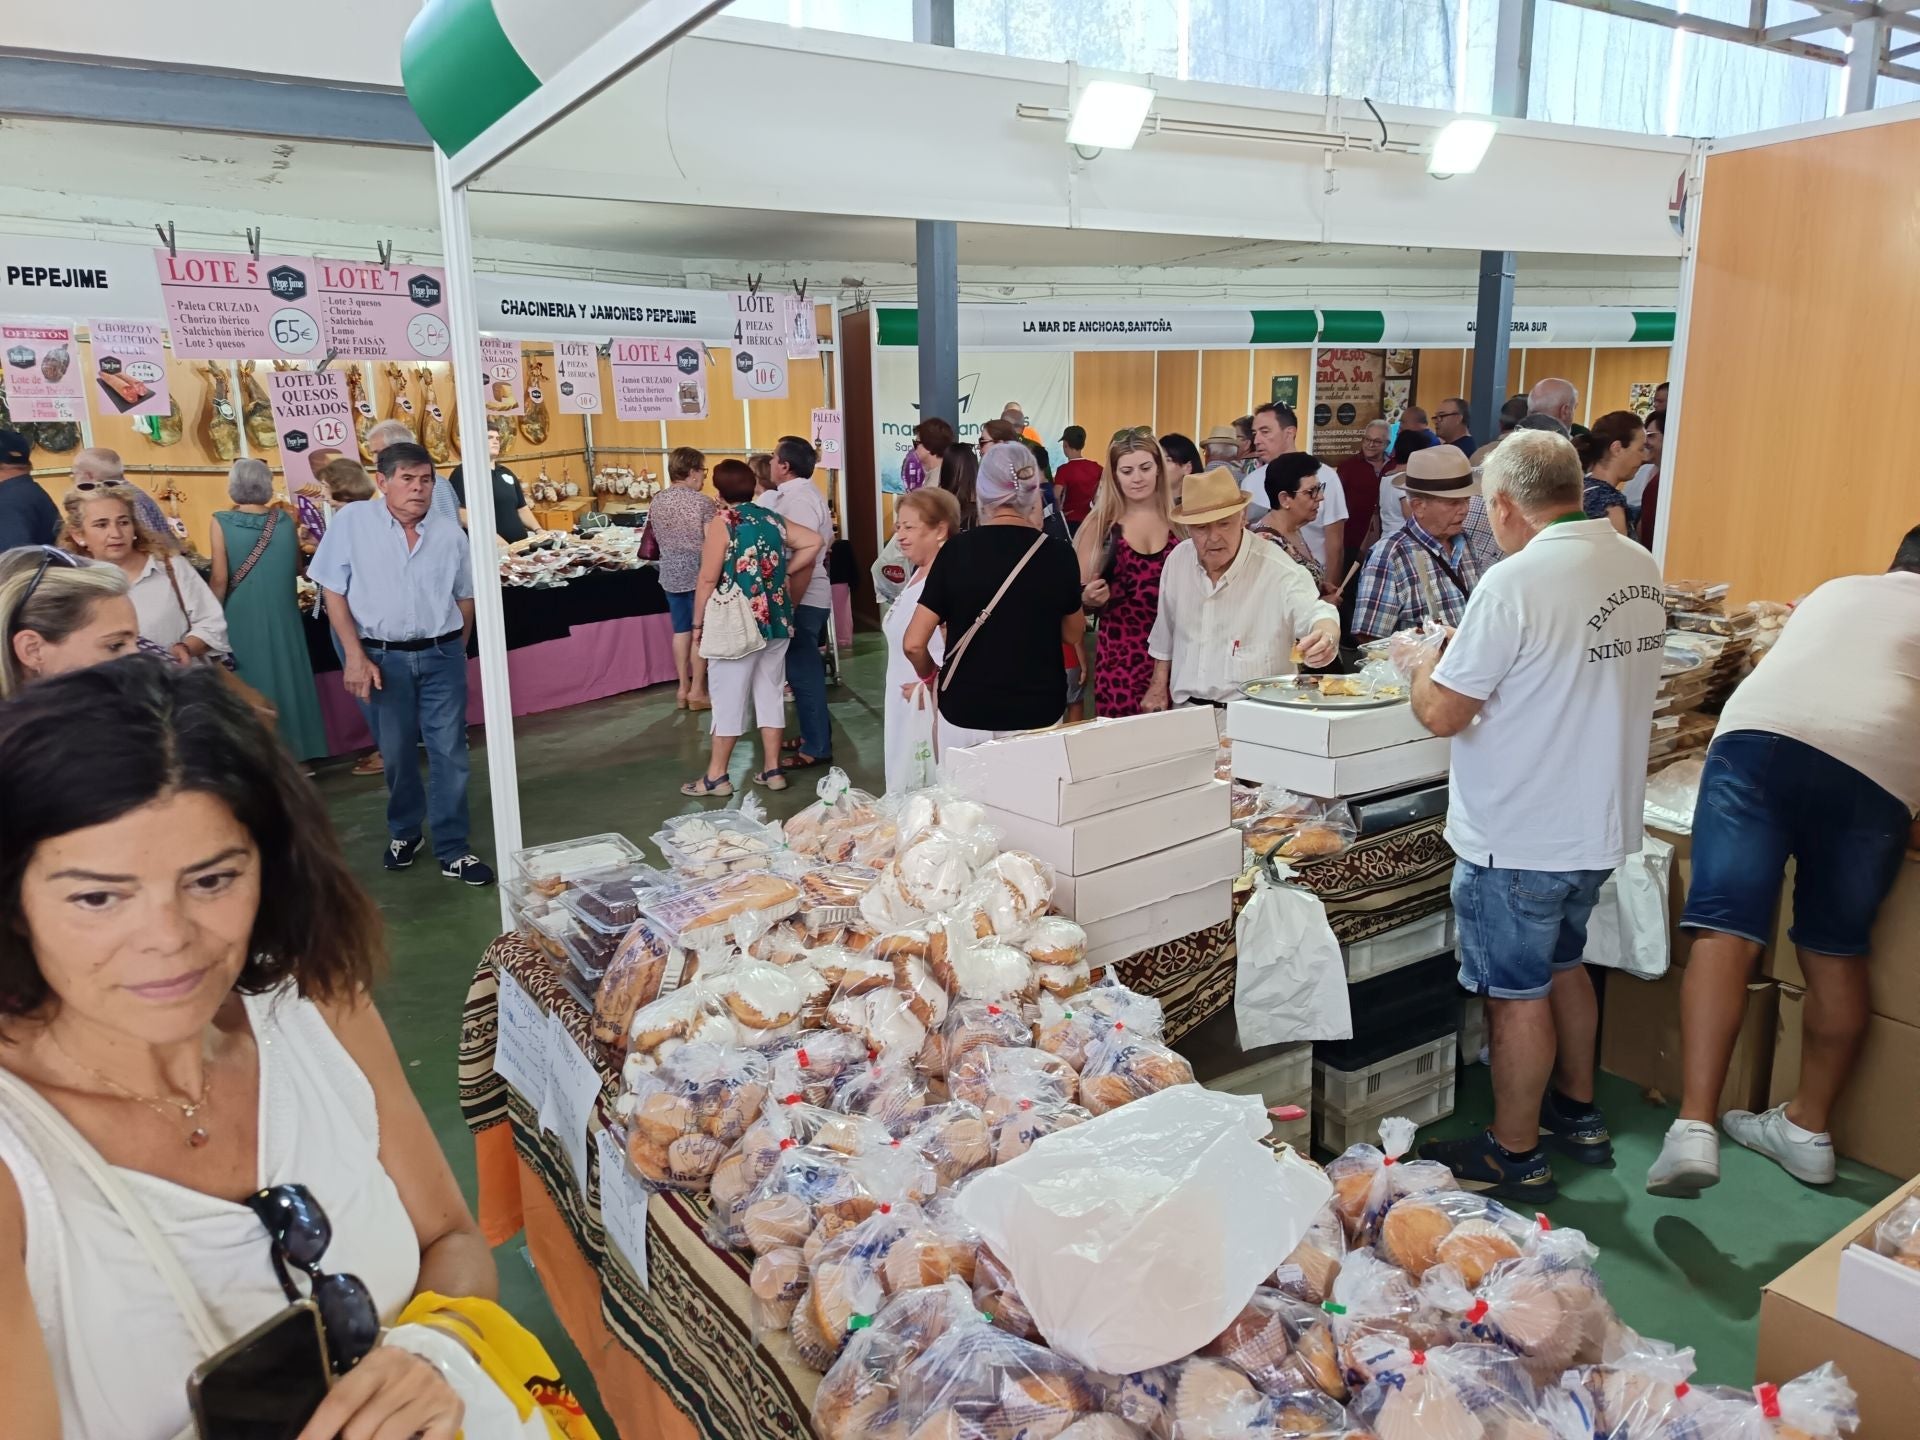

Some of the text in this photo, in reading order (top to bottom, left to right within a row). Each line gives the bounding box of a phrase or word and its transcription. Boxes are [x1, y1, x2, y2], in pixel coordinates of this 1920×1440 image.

[7, 266, 108, 289] PEPEJIME
[166, 258, 258, 284] LOTE 5
[323, 266, 399, 292] LOTE 7
[177, 300, 260, 313] Paleta CRUZADA
[328, 296, 382, 308] Lote 3 quesos
[738, 295, 775, 313] LOTE
[329, 307, 362, 316] Chorizo
[501, 300, 697, 324] CHACINERIA Y JAMONES PEPEJIME
[180, 314, 250, 326] Chorizo ibérico
[330, 317, 374, 327] Salchichón
[1023, 318, 1172, 333] LA MAR DE ANCHOAS,SANTOÑA
[1531, 321, 1547, 332] SUR
[97, 323, 152, 334] CHORIZO Y
[182, 326, 265, 338] Salchichón ibérico
[274, 319, 313, 344] 65€
[331, 327, 355, 336] Lomo
[734, 319, 773, 345] 4 PIEZAS
[185, 338, 246, 352] Lote 3 quesos
[332, 336, 350, 346] Paté
[502, 341, 513, 349] DE
[561, 344, 589, 356] LOTE
[618, 344, 671, 362] LOTE 4
[558, 359, 565, 378] 4
[275, 373, 336, 388] LOTE DE
[641, 376, 672, 384] CRUZADO
[755, 368, 776, 385] 10 €
[282, 388, 339, 405] QUESOS
[276, 402, 349, 417] VARIADOS
[813, 412, 840, 423] PALETAS
[316, 422, 342, 441] 12€
[1588, 630, 1666, 663] NIÑO JESÚ
